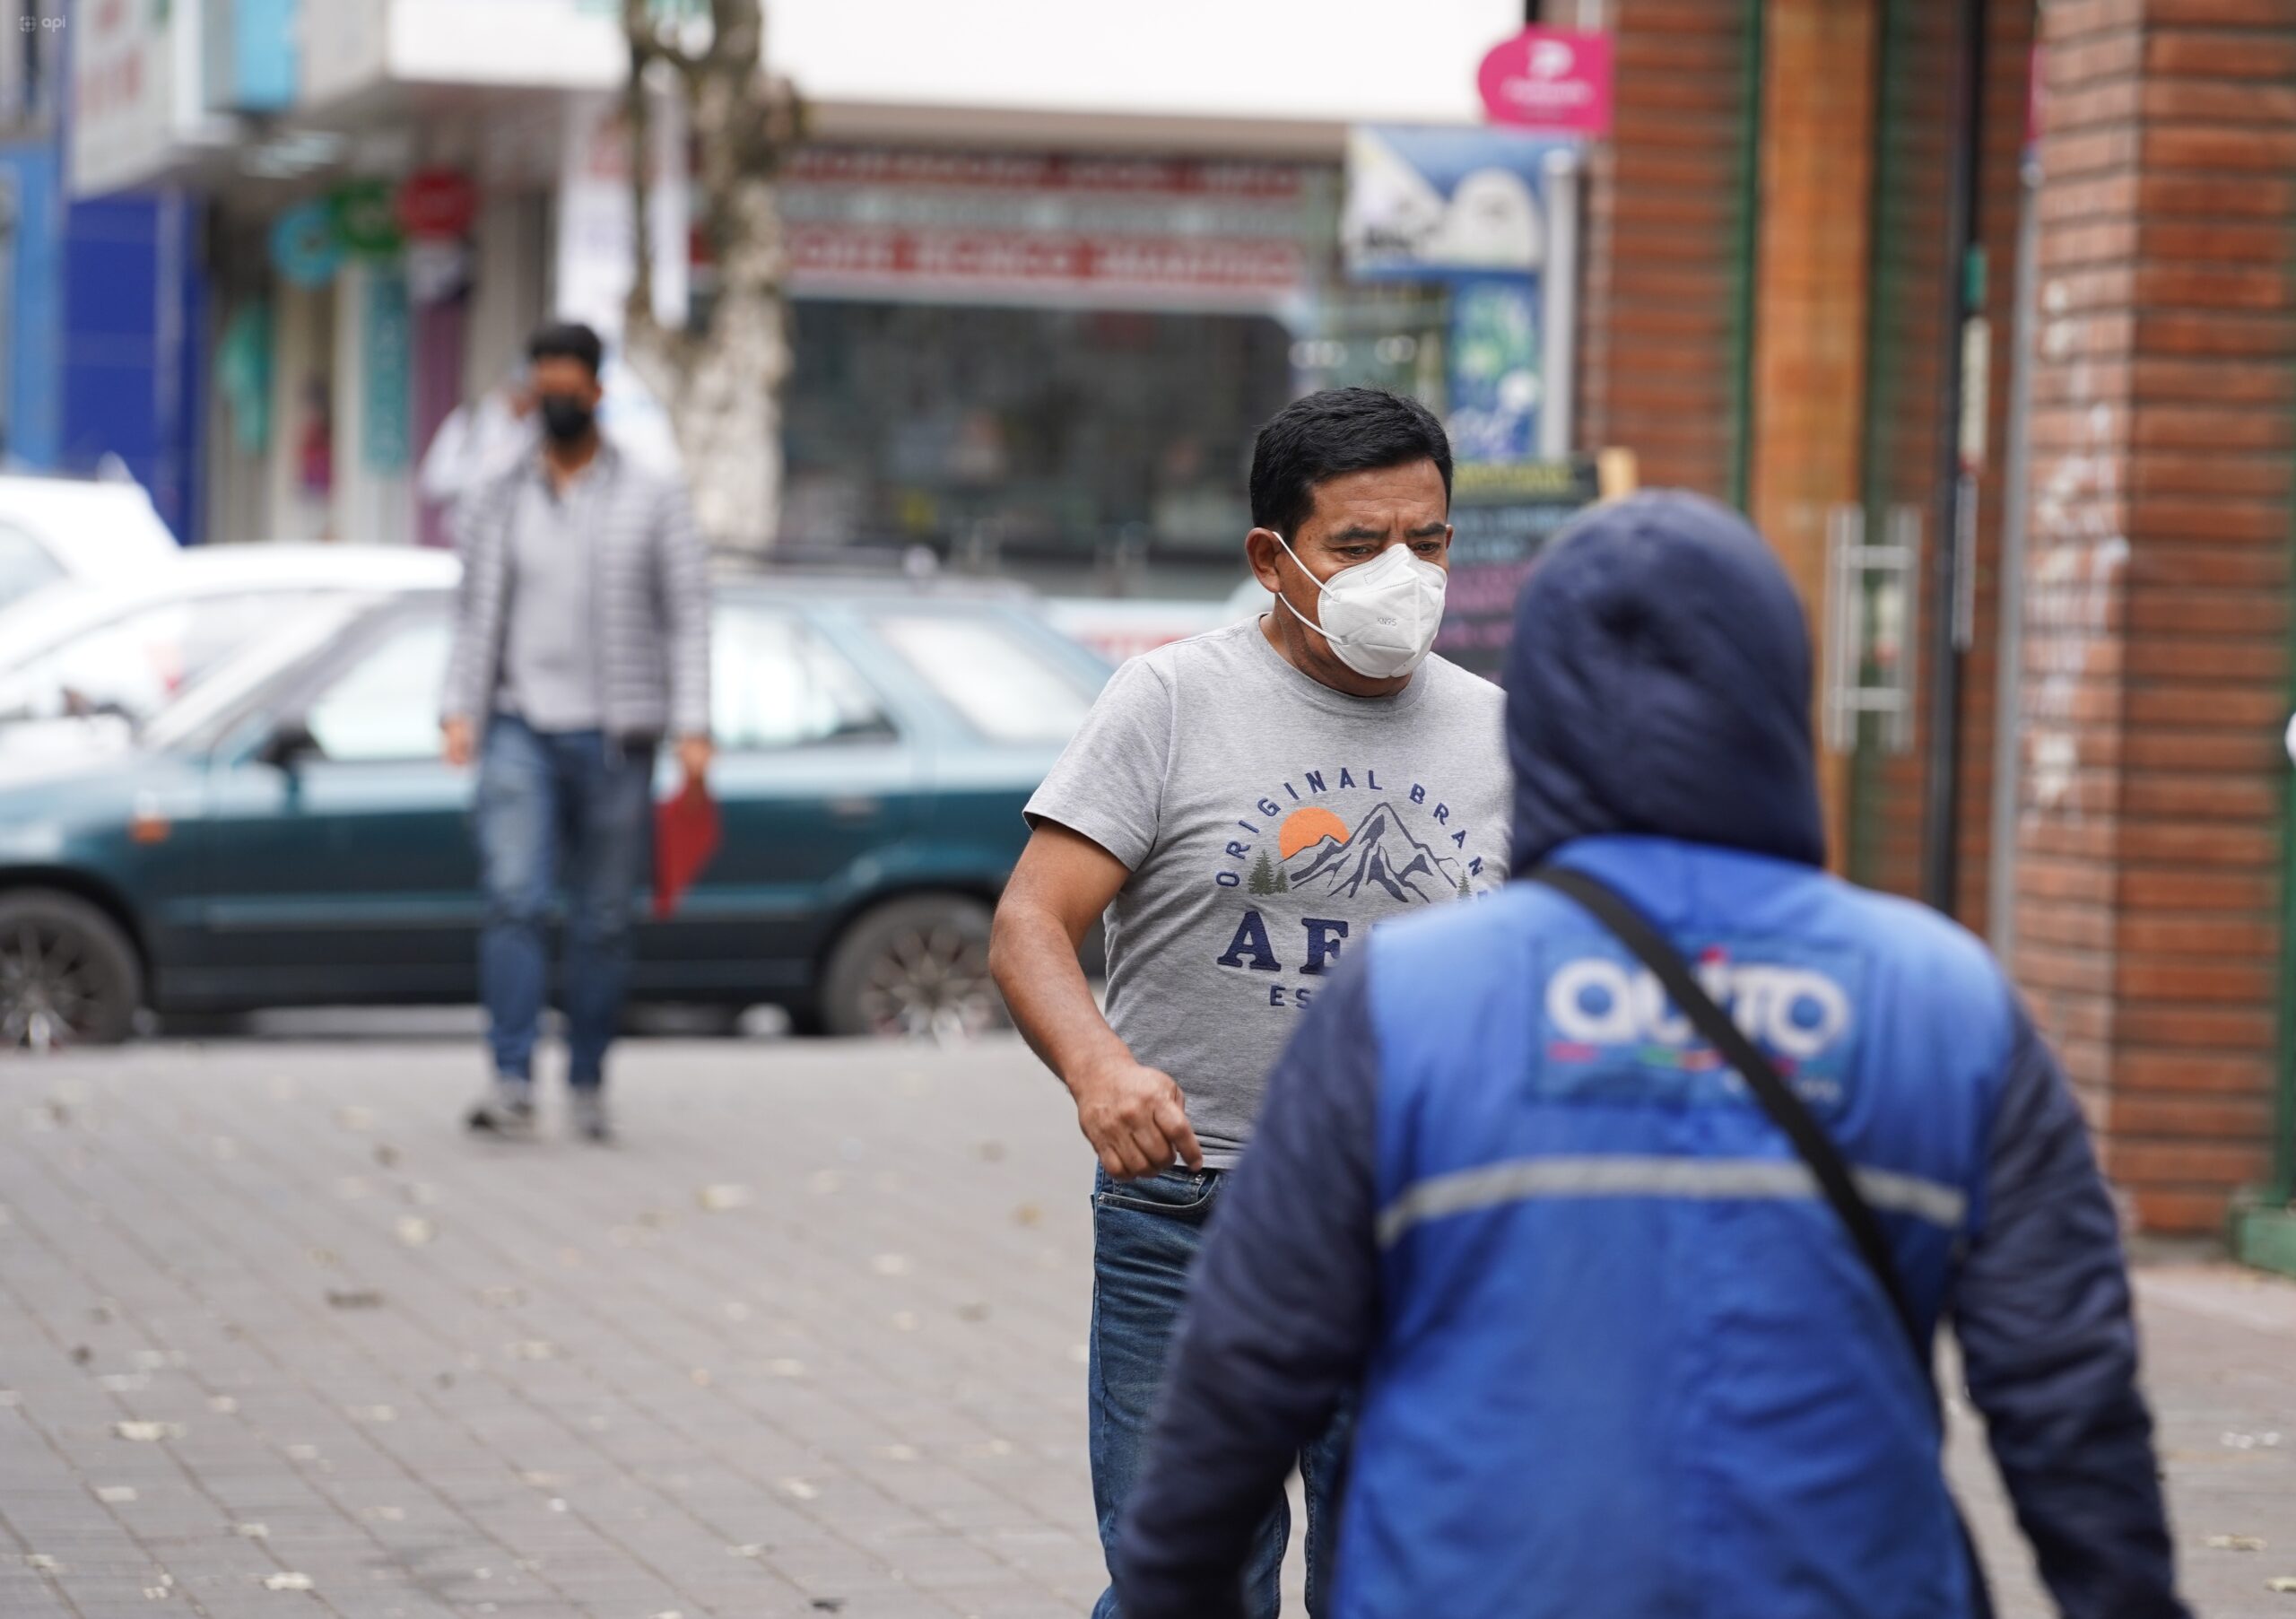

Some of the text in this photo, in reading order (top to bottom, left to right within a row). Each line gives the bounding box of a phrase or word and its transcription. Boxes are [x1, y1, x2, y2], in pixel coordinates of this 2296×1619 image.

[1216, 768, 1489, 901] ORIGINAL BRAN
[1217, 911, 1381, 975] AF
[1270, 986, 1311, 1009] ES
